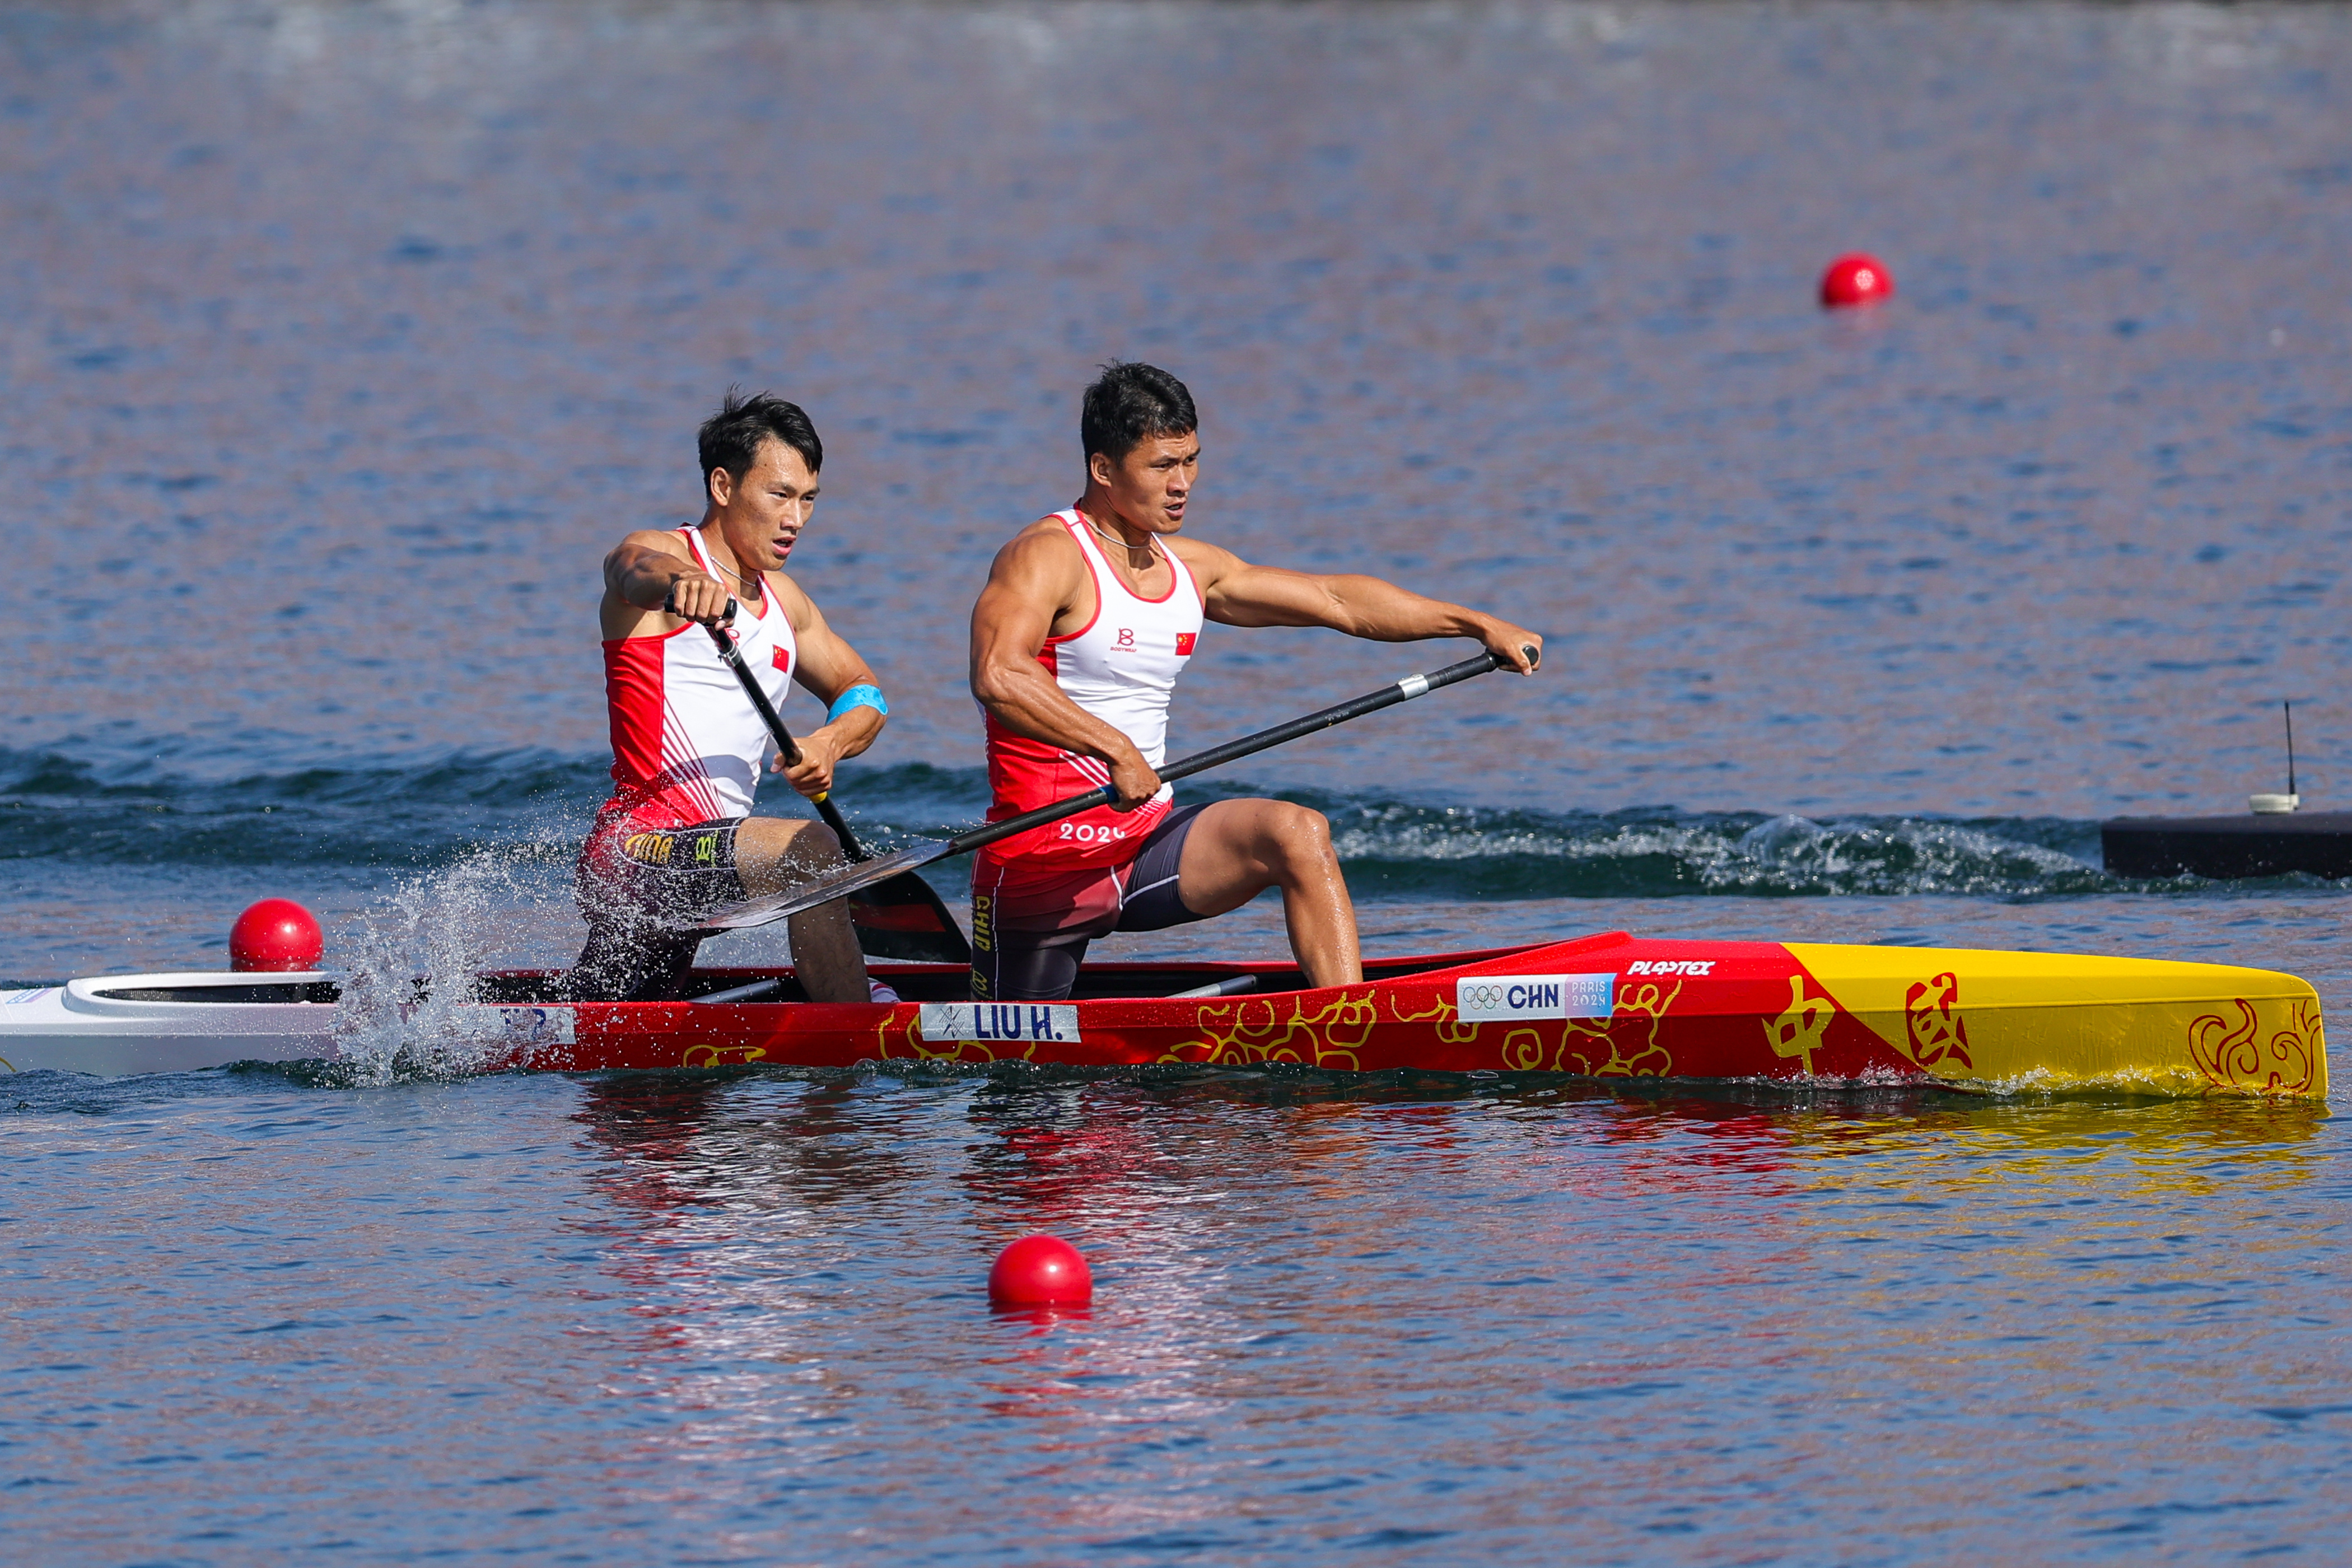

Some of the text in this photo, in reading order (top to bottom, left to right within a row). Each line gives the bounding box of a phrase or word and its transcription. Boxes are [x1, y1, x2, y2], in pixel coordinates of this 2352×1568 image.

[1059, 823, 1126, 843] 2024
[1508, 984, 1558, 1008] CHN
[1571, 981, 1606, 993] PARIS
[1571, 994, 1606, 1006] 2024
[974, 1005, 1063, 1040] LIU H.
